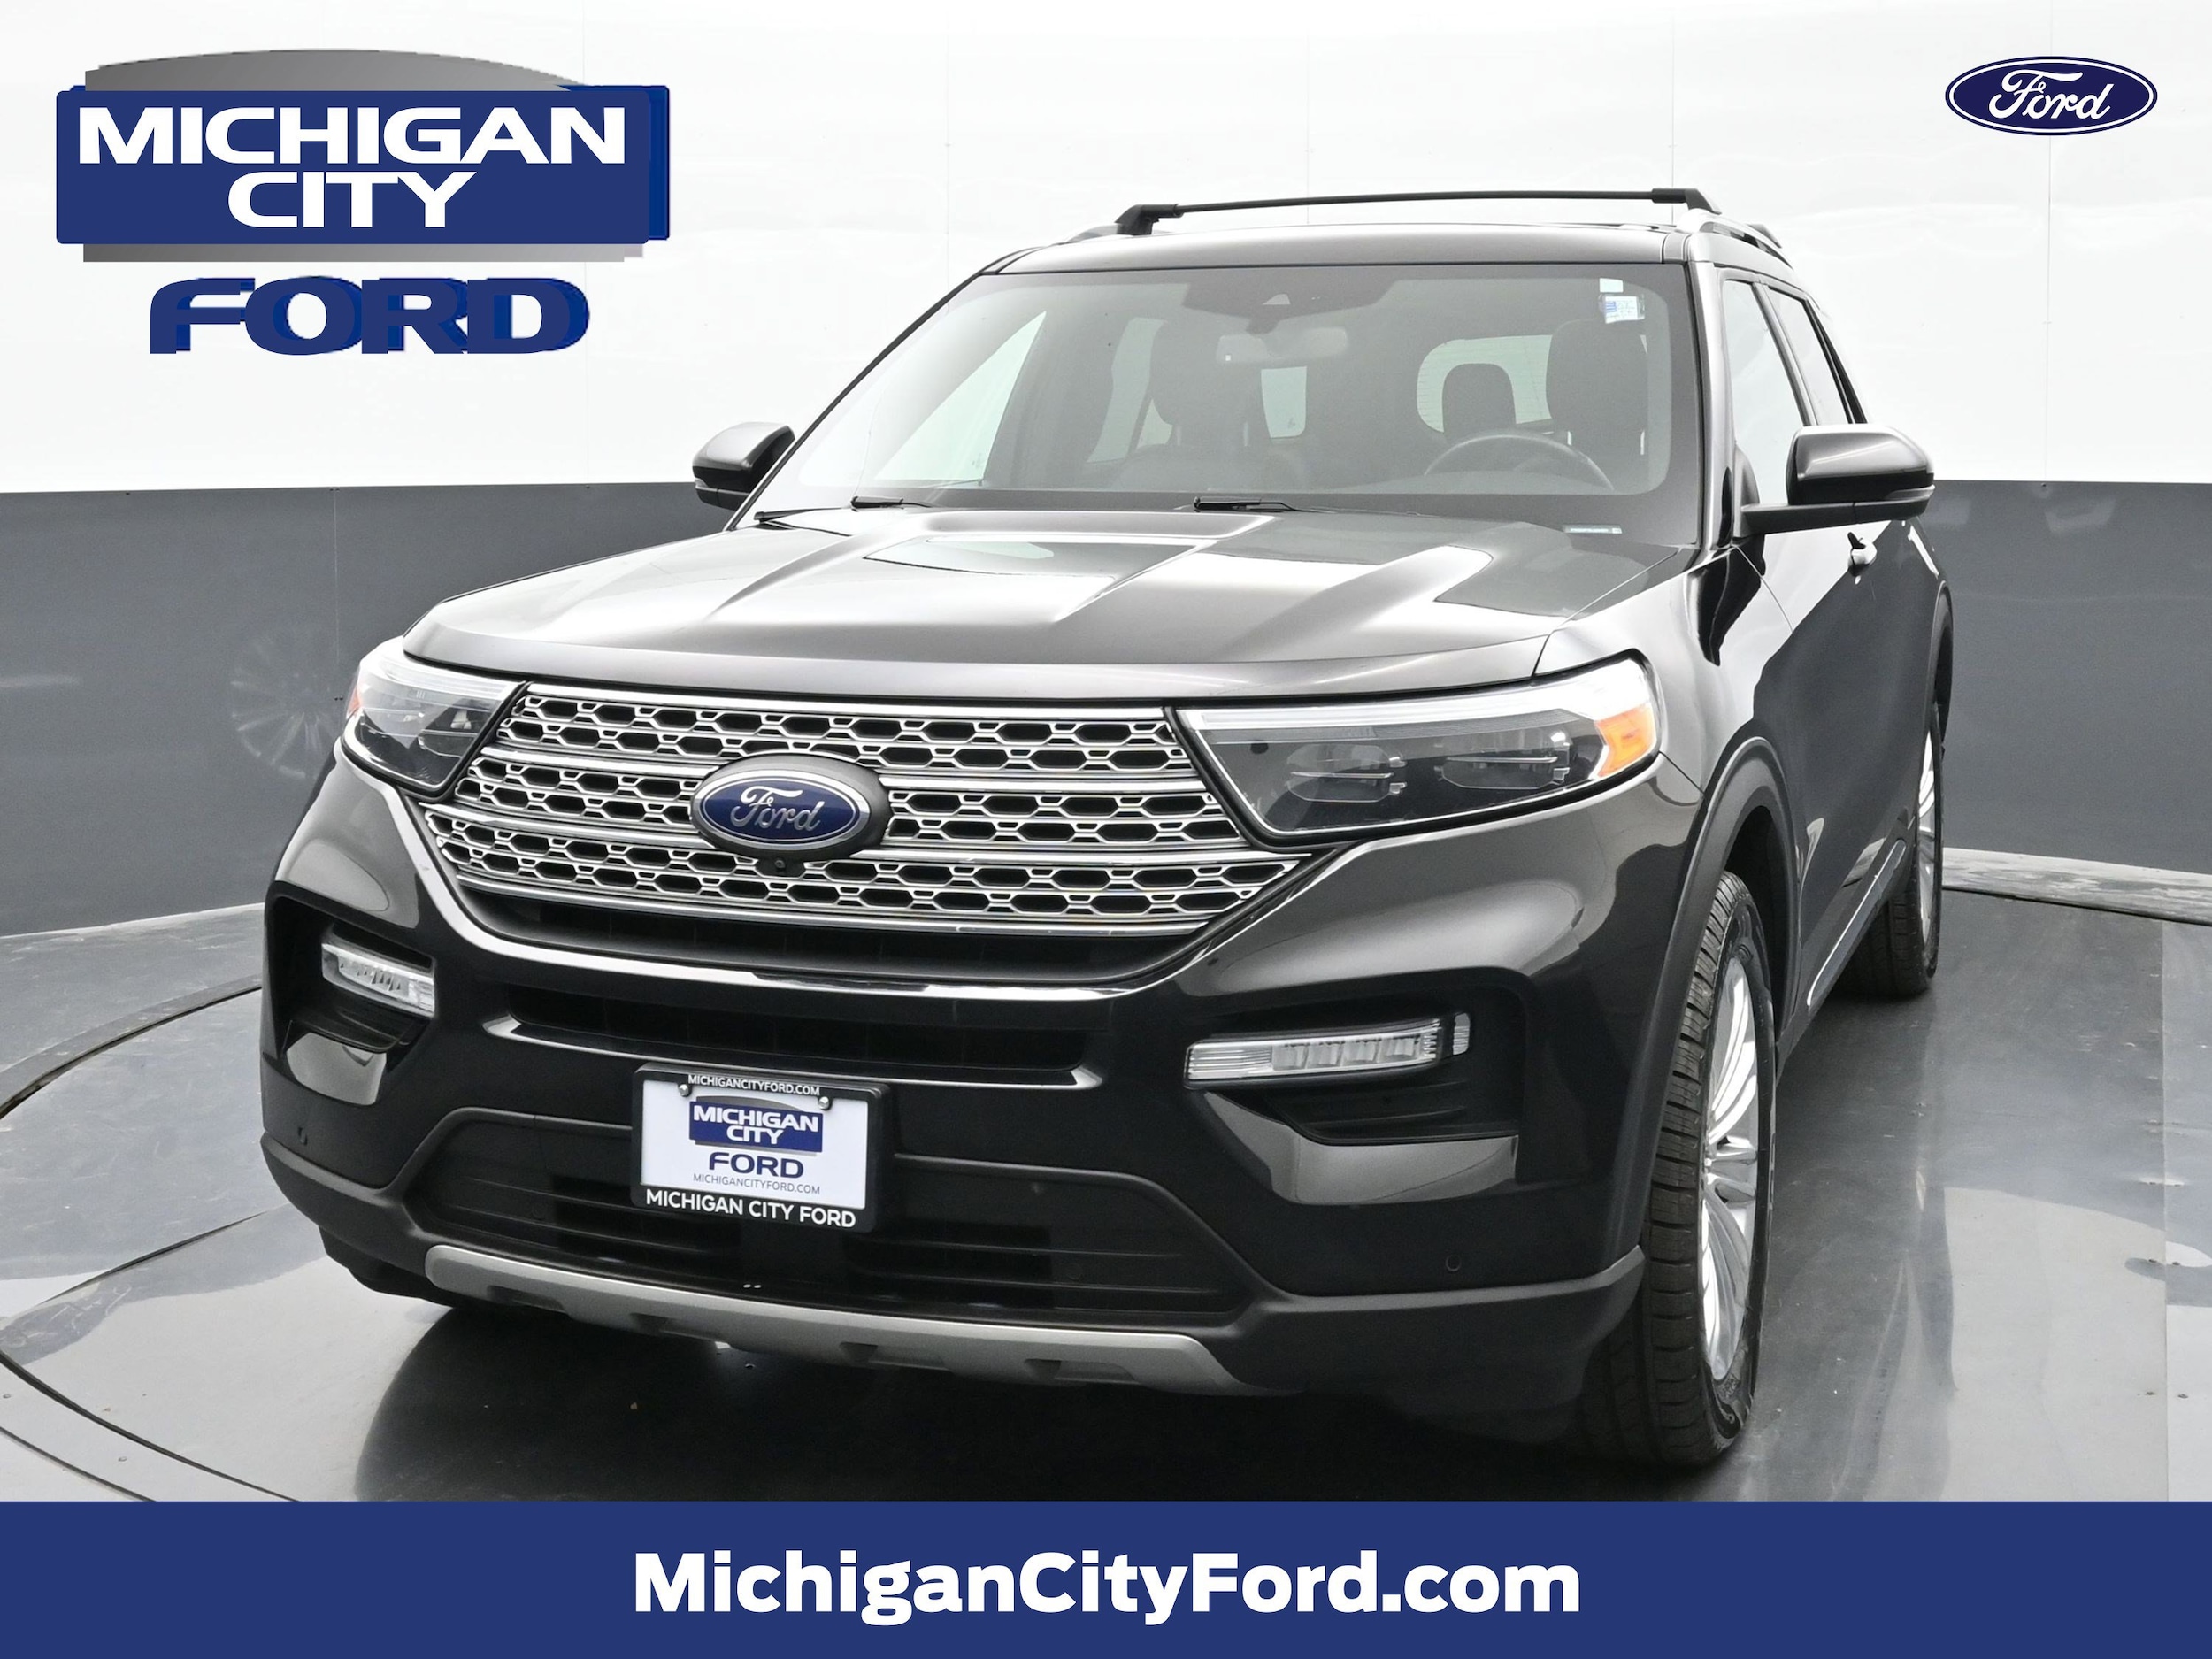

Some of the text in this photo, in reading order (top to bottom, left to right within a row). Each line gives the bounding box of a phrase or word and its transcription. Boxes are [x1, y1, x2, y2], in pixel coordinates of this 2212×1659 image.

[731, 786, 825, 831] Ford
[688, 1075, 819, 1095] MICHIGANCITYFORD.COM
[694, 1106, 818, 1132] MICHIGAN
[726, 1125, 784, 1145] CITY
[710, 1152, 803, 1179] FORD
[694, 1174, 820, 1194] MICHIGANCITYFORD.COM
[646, 1189, 856, 1228] MICHIGAN CITY FORD
